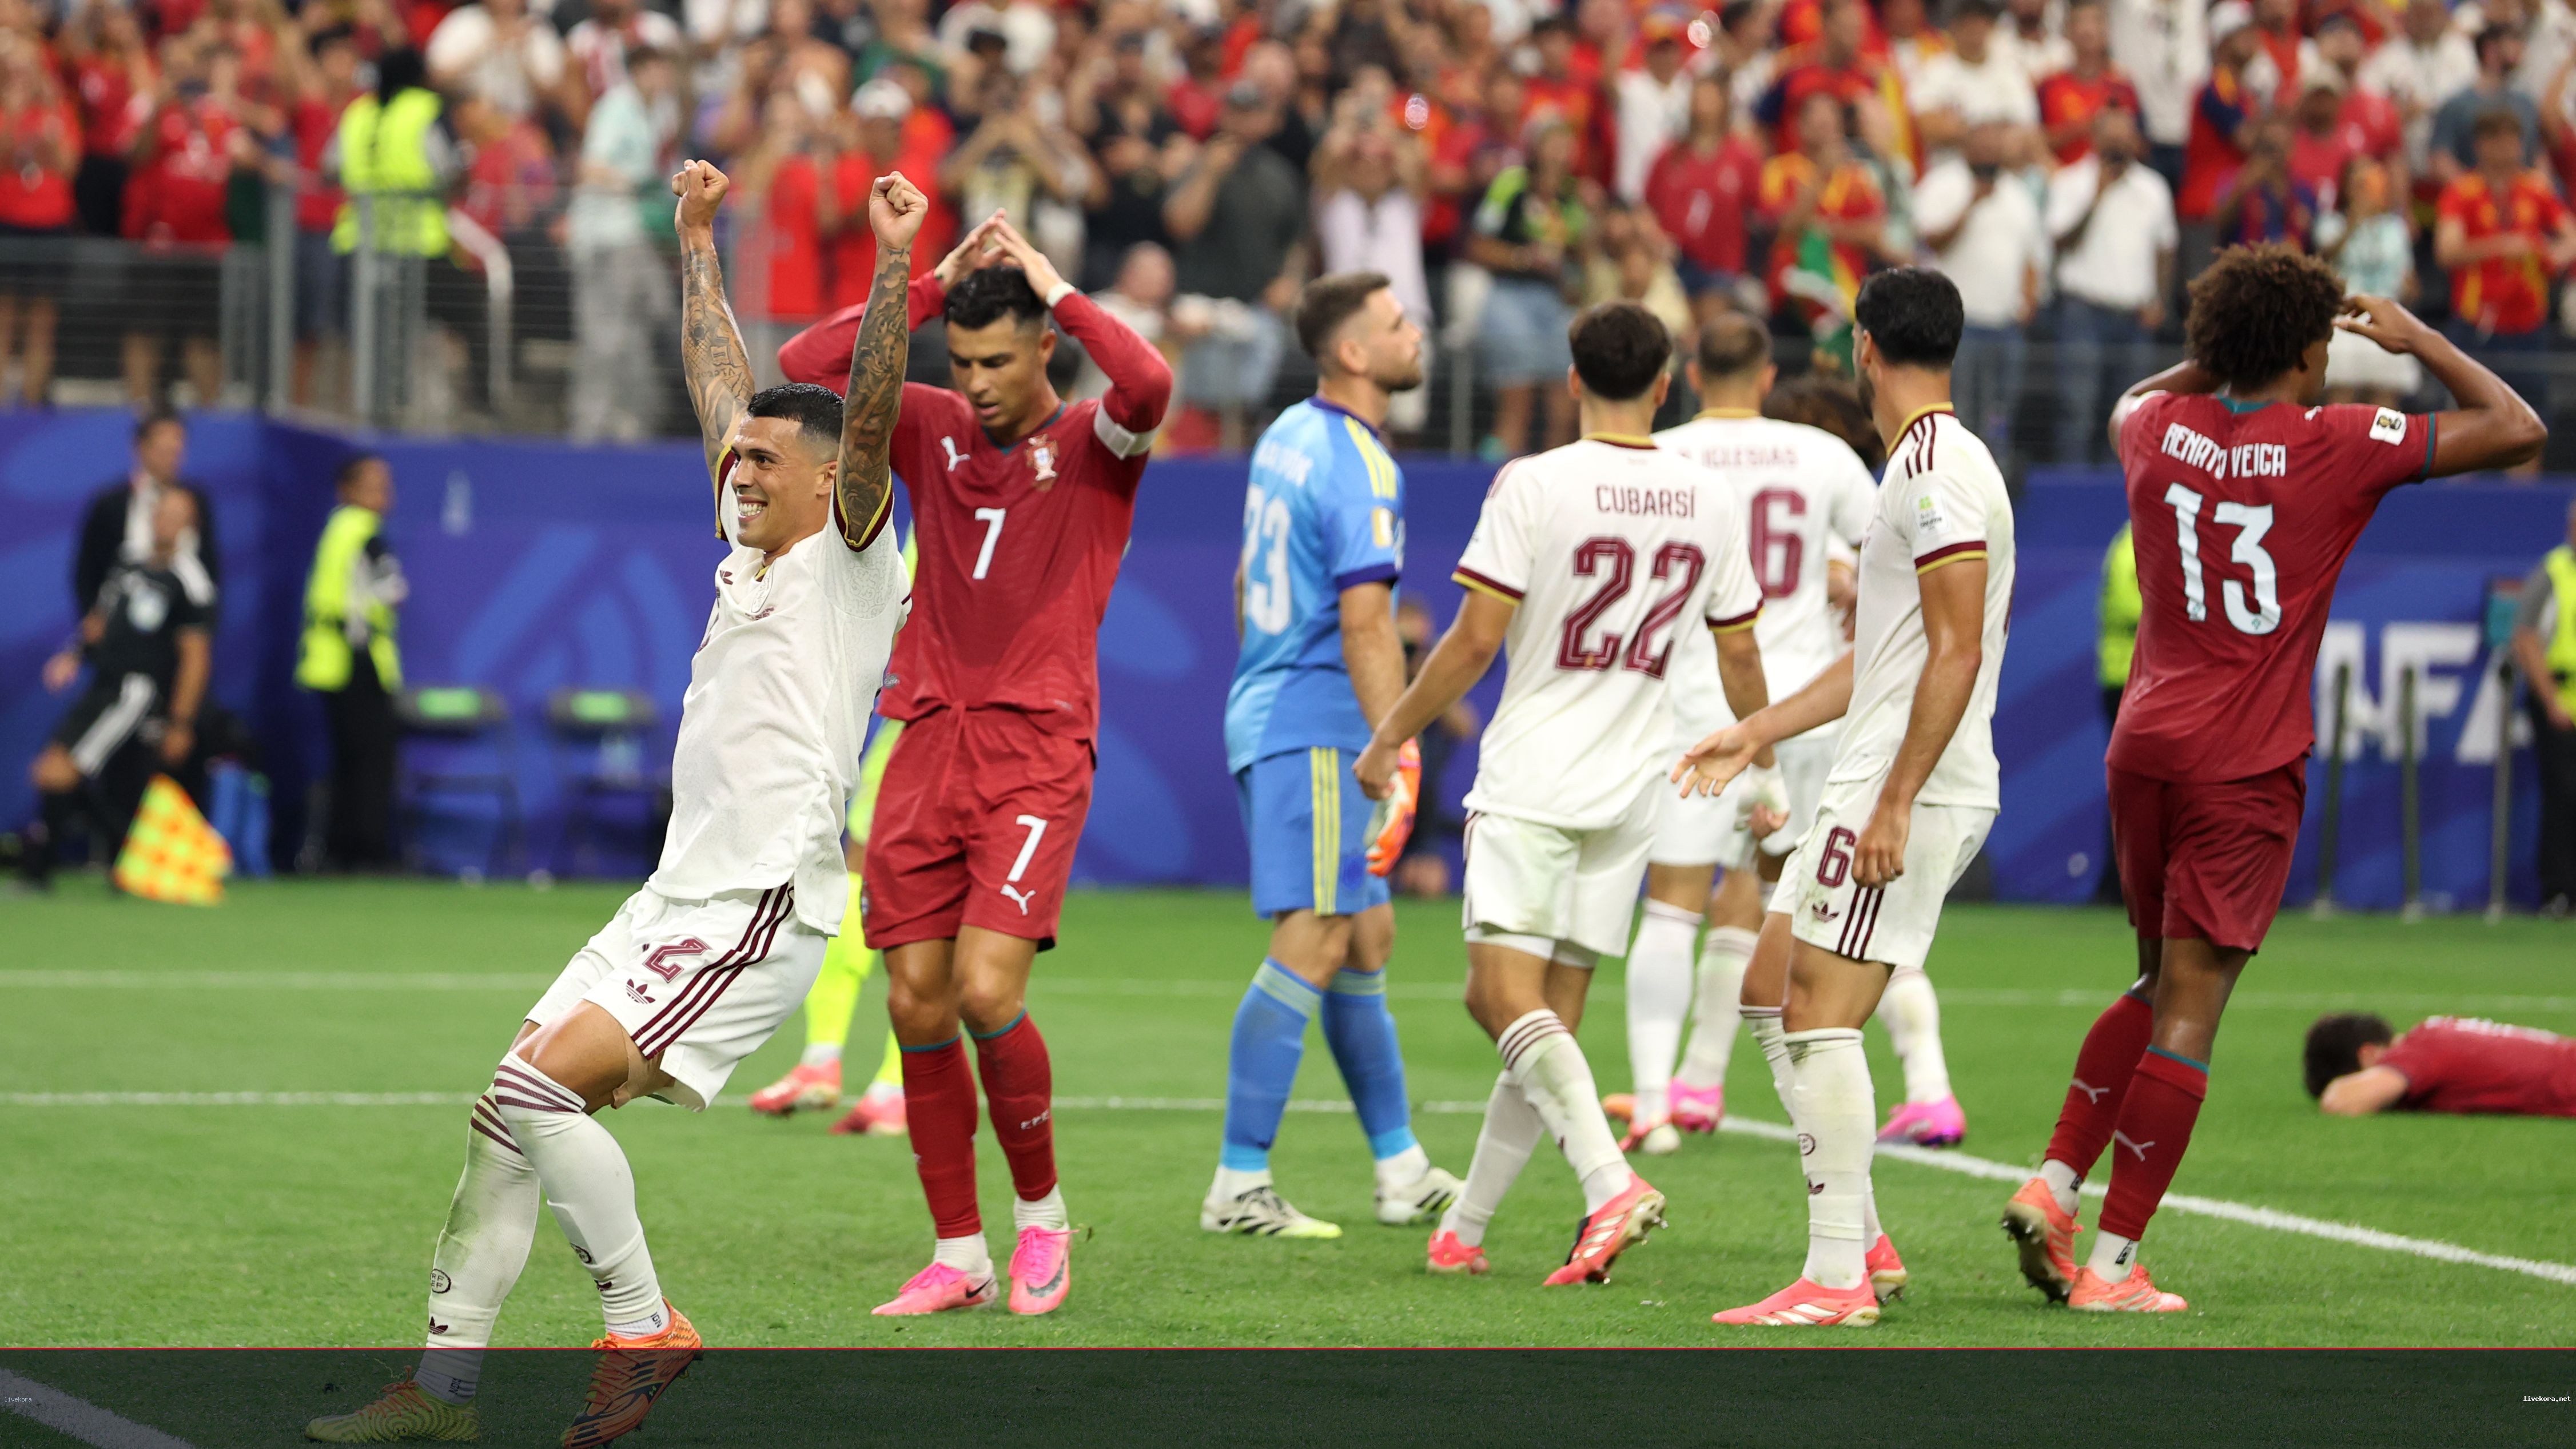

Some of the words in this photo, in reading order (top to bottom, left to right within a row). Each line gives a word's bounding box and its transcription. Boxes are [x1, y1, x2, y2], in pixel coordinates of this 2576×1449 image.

[2161, 421, 2227, 480] RENATO
[2231, 443, 2287, 478] VEIGA
[1596, 485, 1697, 519] CUBARSÍ
[972, 507, 1006, 580] 7
[2163, 482, 2283, 636] 13
[1555, 536, 1706, 680] 22
[1006, 814, 1049, 883] 7
[1816, 826, 1857, 889] 6
[642, 937, 713, 984] 2
[650, 1313, 662, 1328] IGN
